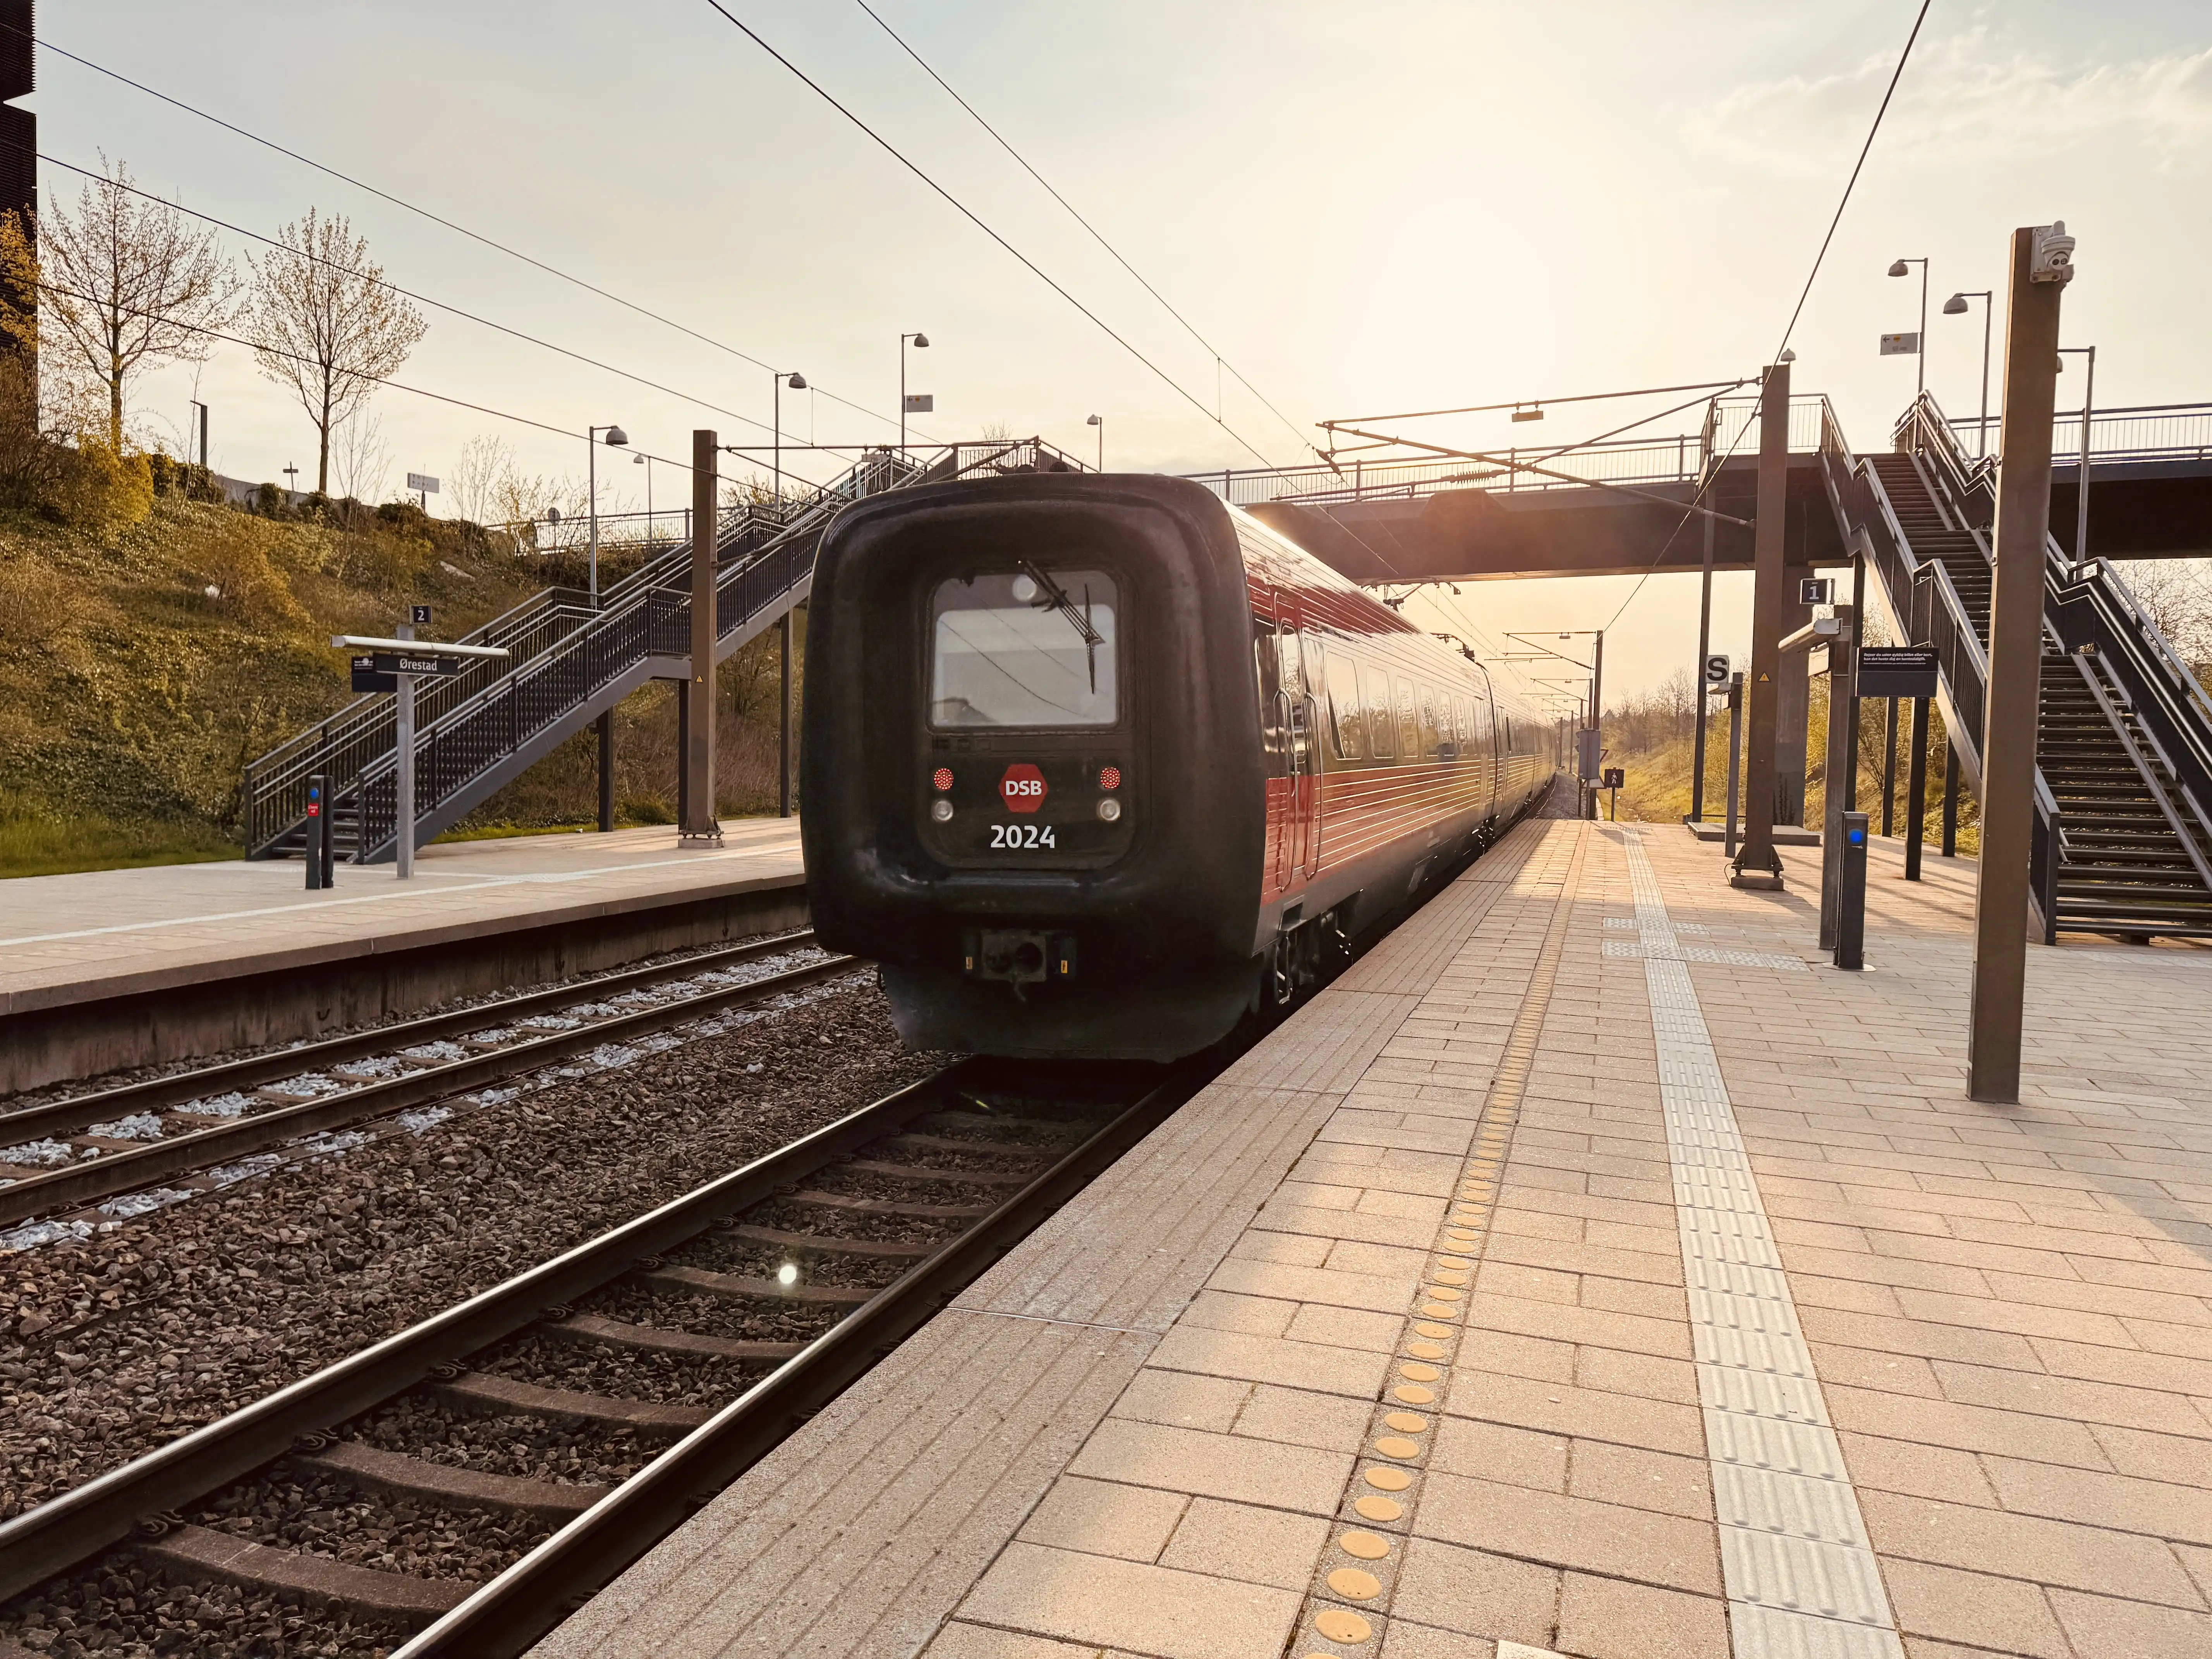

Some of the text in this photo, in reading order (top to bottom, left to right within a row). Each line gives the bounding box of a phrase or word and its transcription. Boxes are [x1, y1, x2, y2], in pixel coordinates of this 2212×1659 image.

[1809, 586, 1819, 599] 1
[418, 610, 424, 621] 2
[399, 658, 438, 671] Ørestad
[1707, 657, 1728, 681] S
[1005, 780, 1042, 796] DSB
[991, 825, 1055, 848] 2024
